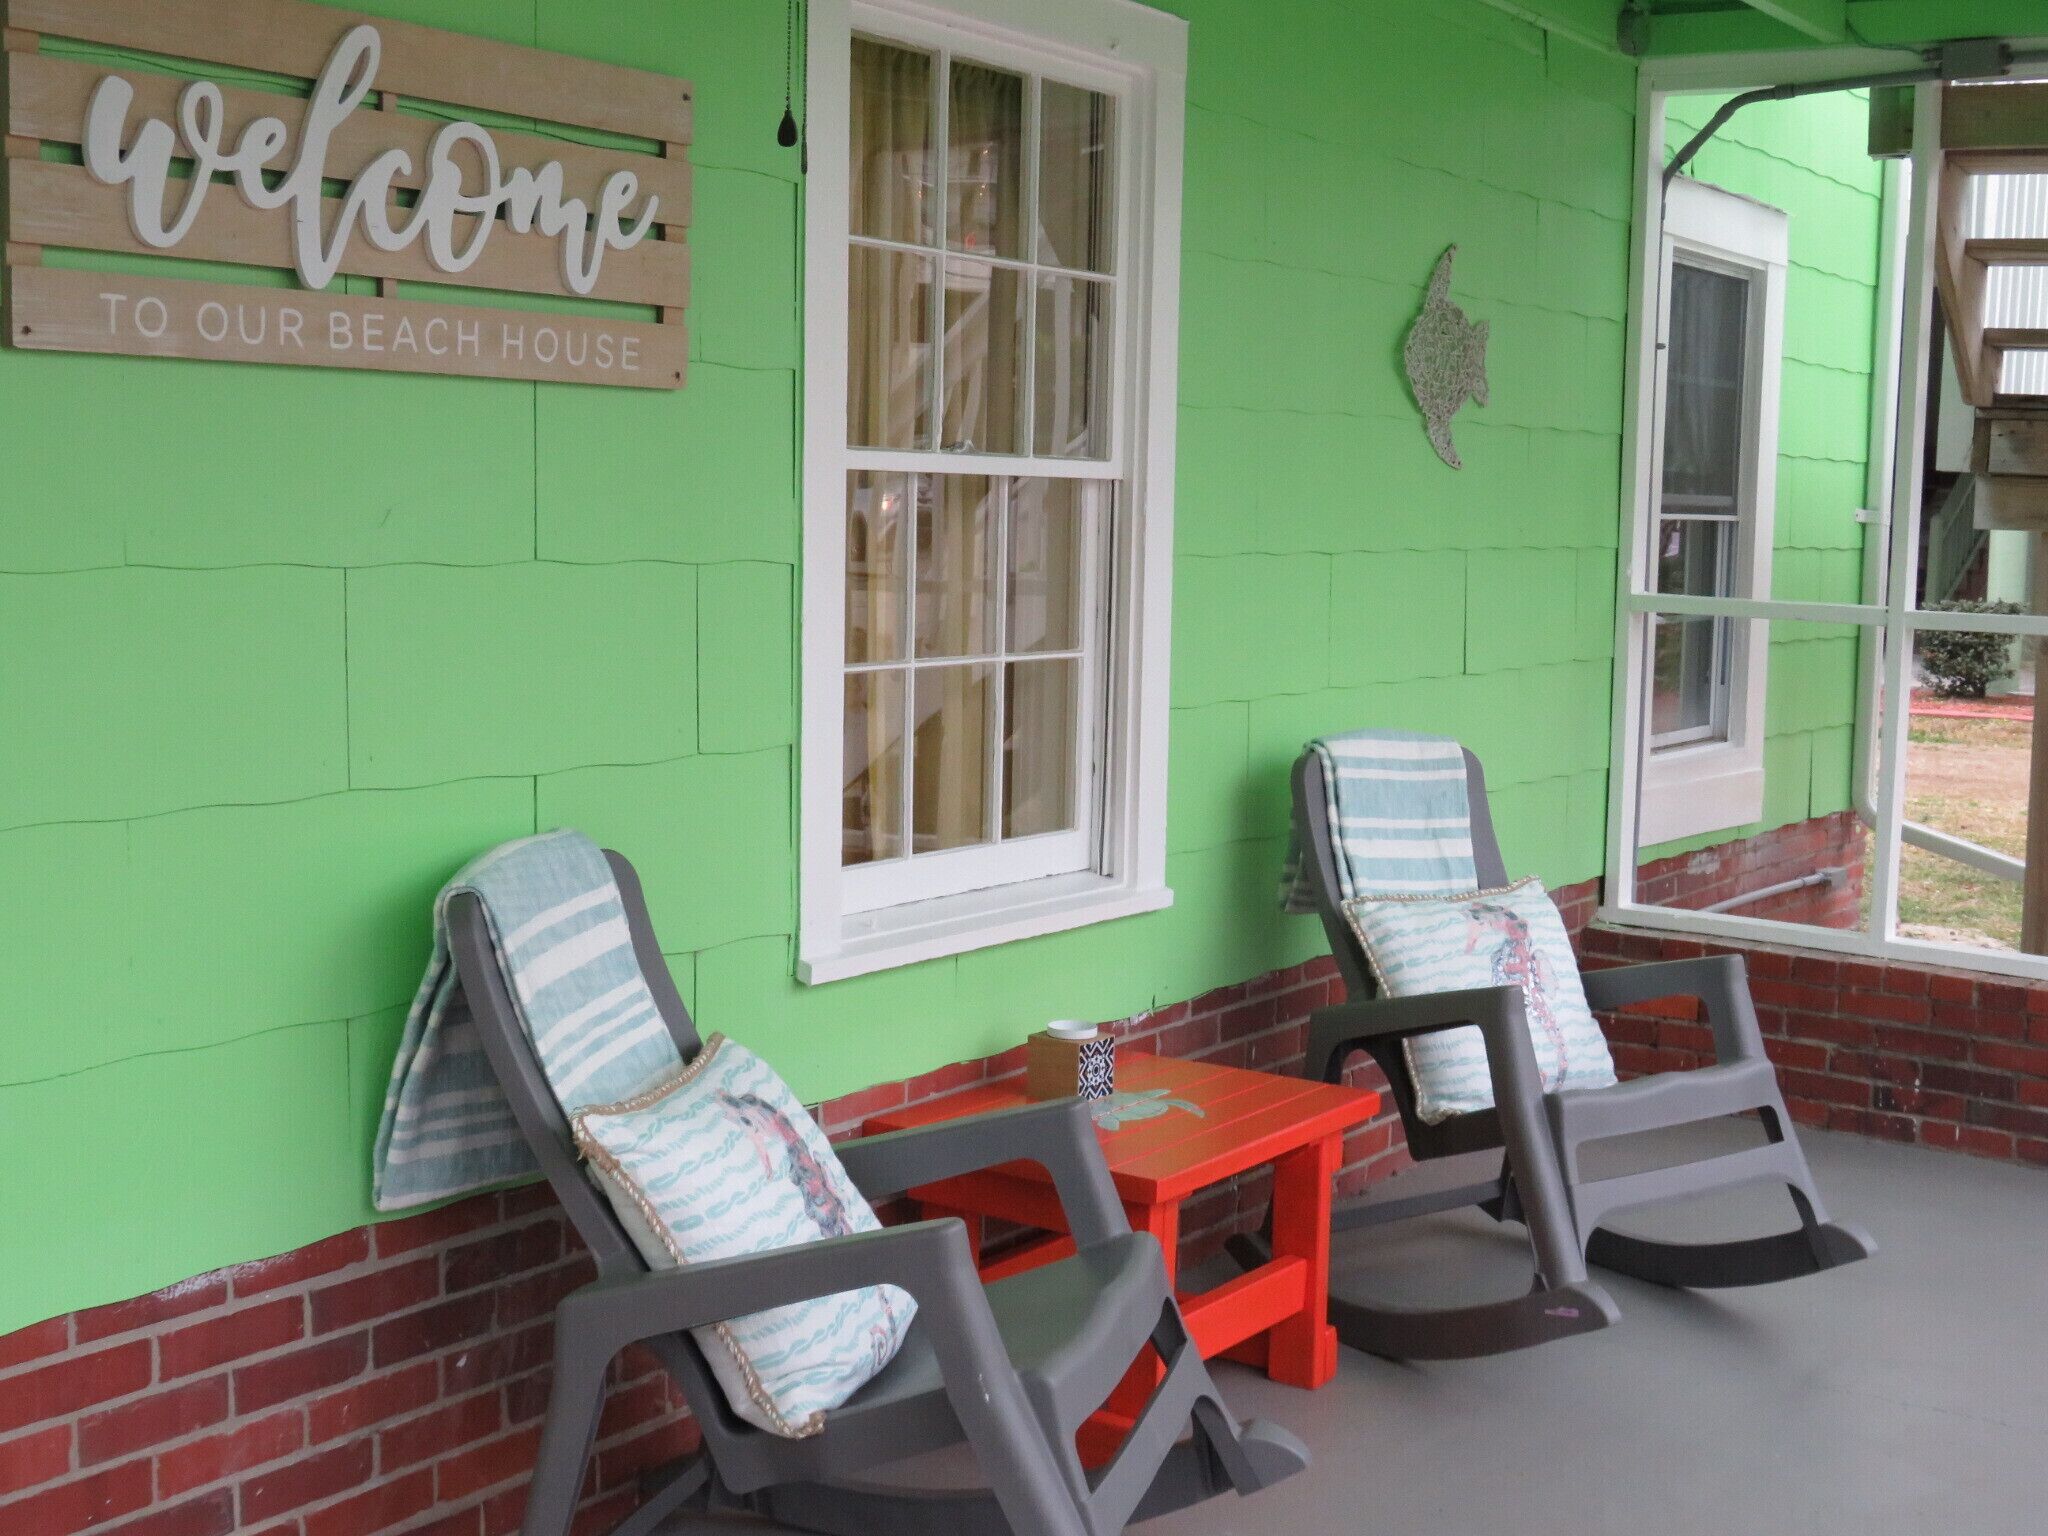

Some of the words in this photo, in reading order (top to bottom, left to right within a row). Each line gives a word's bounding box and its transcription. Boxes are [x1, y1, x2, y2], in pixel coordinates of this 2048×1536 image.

[83, 24, 658, 294] welcome
[99, 293, 169, 339] TO
[196, 301, 305, 348] OUR
[329, 311, 480, 359] BEACH
[503, 323, 641, 371] HOUSE
